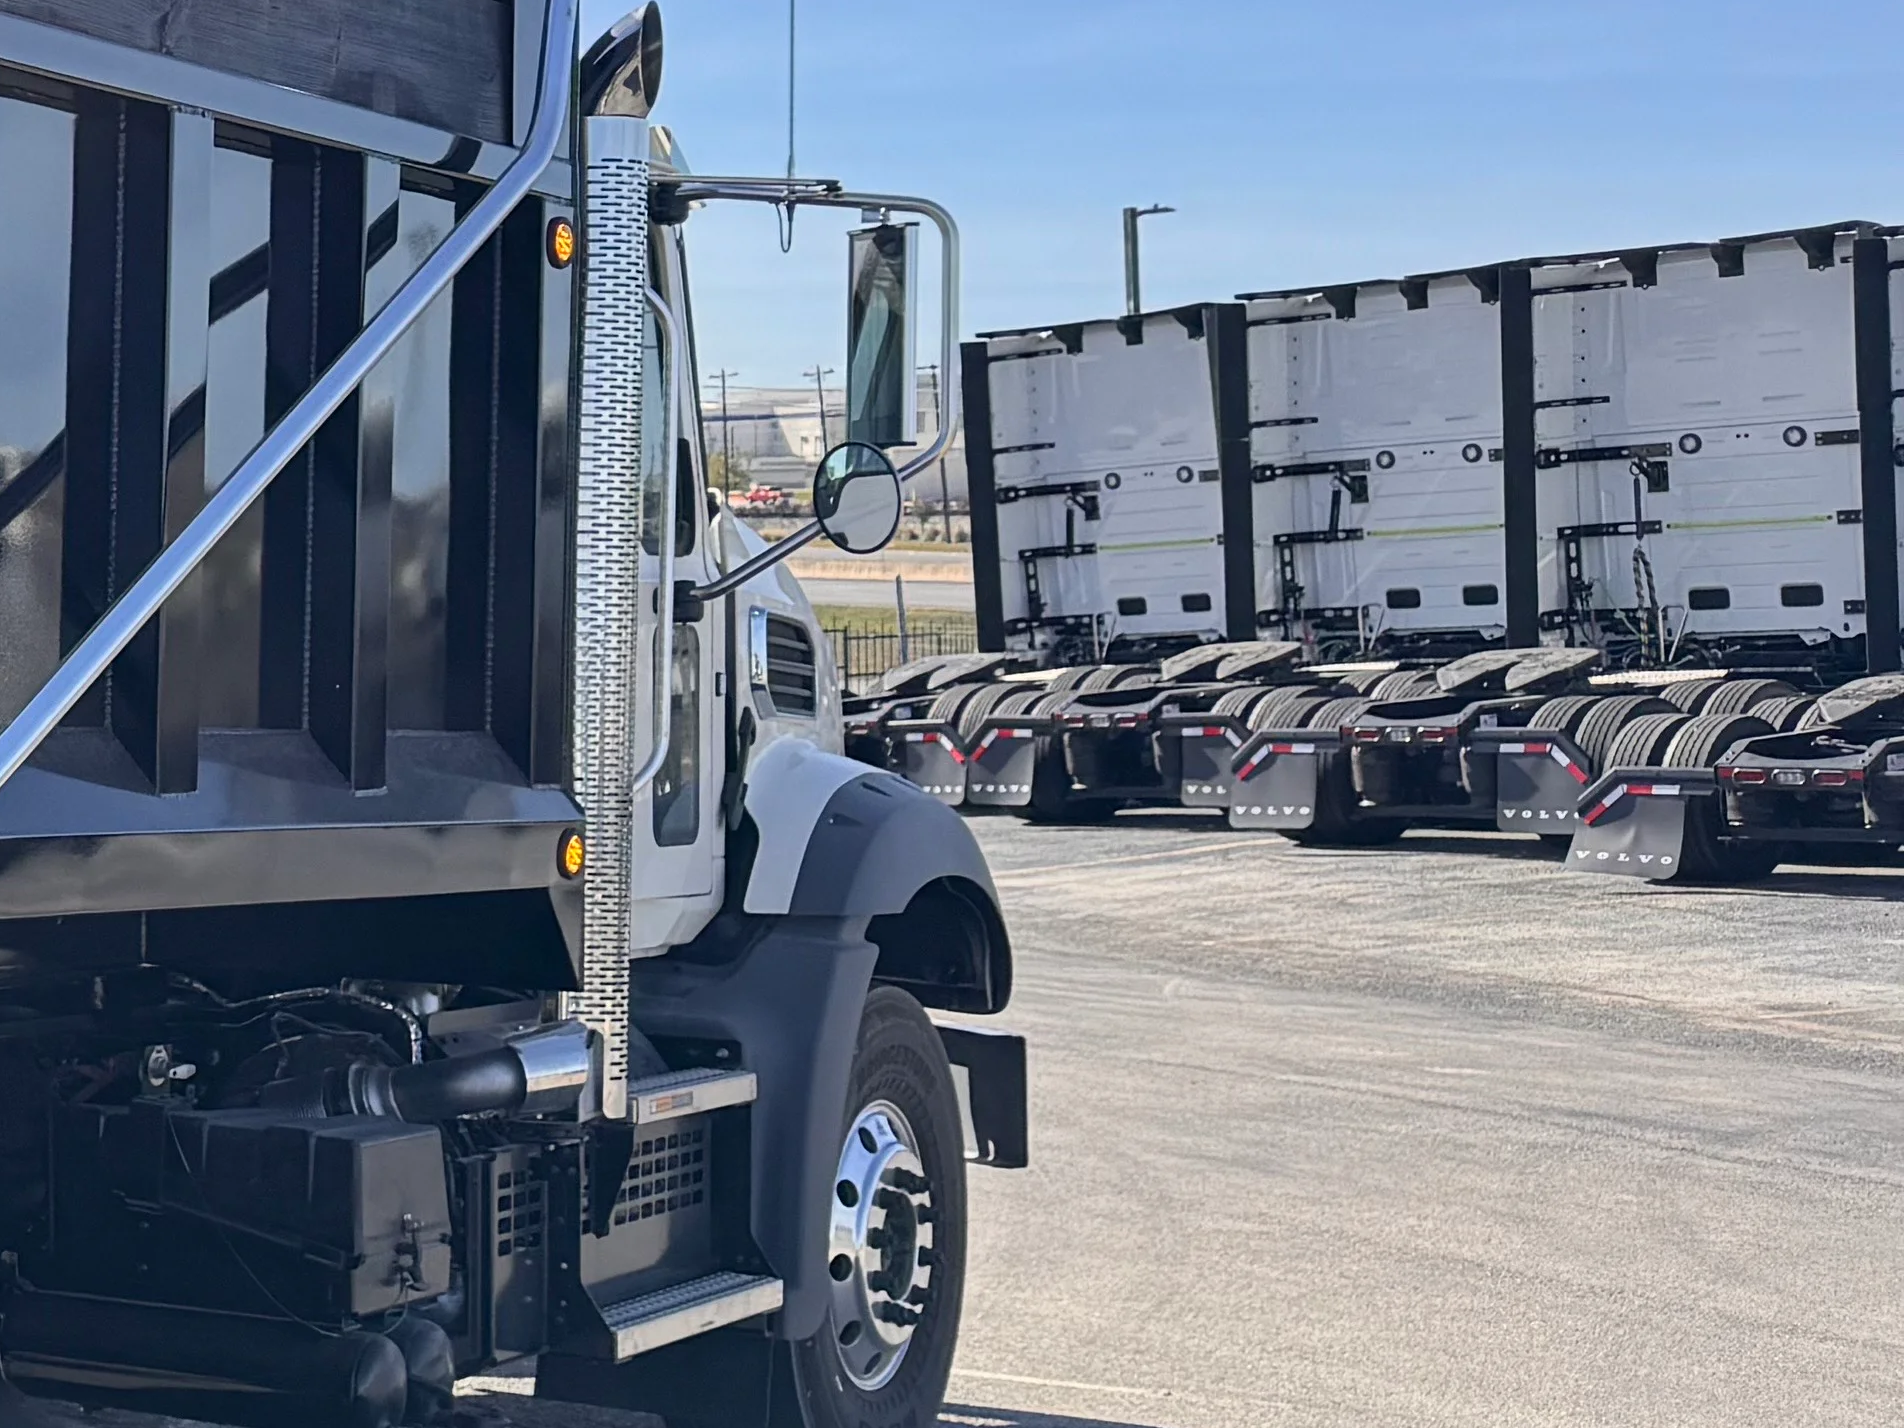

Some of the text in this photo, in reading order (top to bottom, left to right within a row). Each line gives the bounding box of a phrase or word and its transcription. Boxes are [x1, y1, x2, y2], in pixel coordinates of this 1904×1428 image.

[972, 784, 1030, 794] VOLVO
[1186, 785, 1228, 794] VOL
[1235, 806, 1311, 816] VOLVO
[1575, 850, 1673, 865] VOLVO
